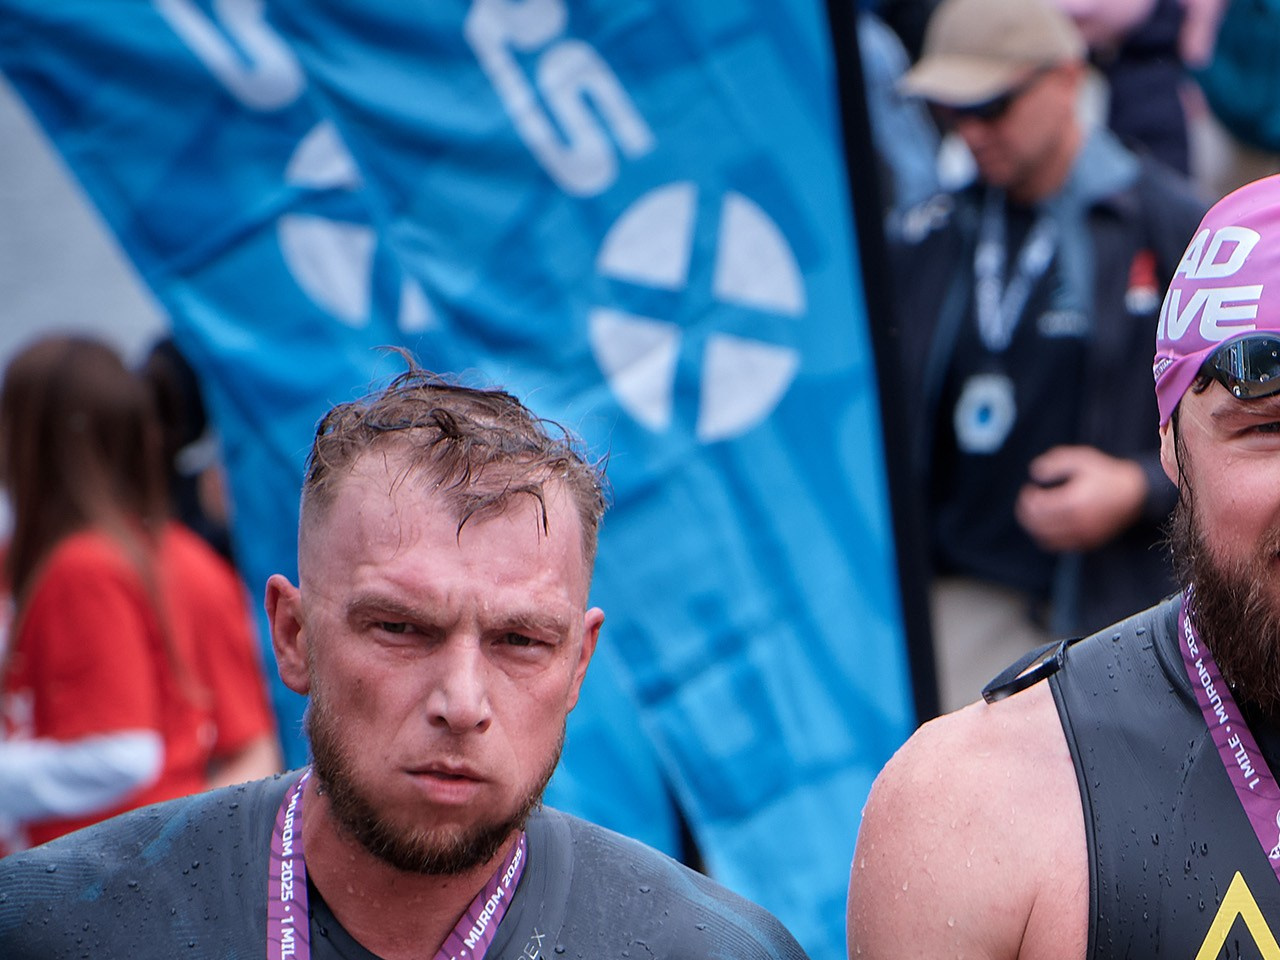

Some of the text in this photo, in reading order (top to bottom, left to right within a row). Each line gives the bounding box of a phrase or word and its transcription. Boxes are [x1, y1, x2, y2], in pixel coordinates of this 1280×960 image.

[1183, 616, 1199, 658] 2025
[1195, 658, 1229, 724] MUROM
[1227, 733, 1256, 779] MILE
[1248, 778, 1260, 790] 1
[282, 792, 298, 857] MUROM
[281, 858, 294, 902] 2025
[463, 886, 505, 950] MUROM
[501, 847, 523, 888] 2025
[281, 915, 295, 925] 1
